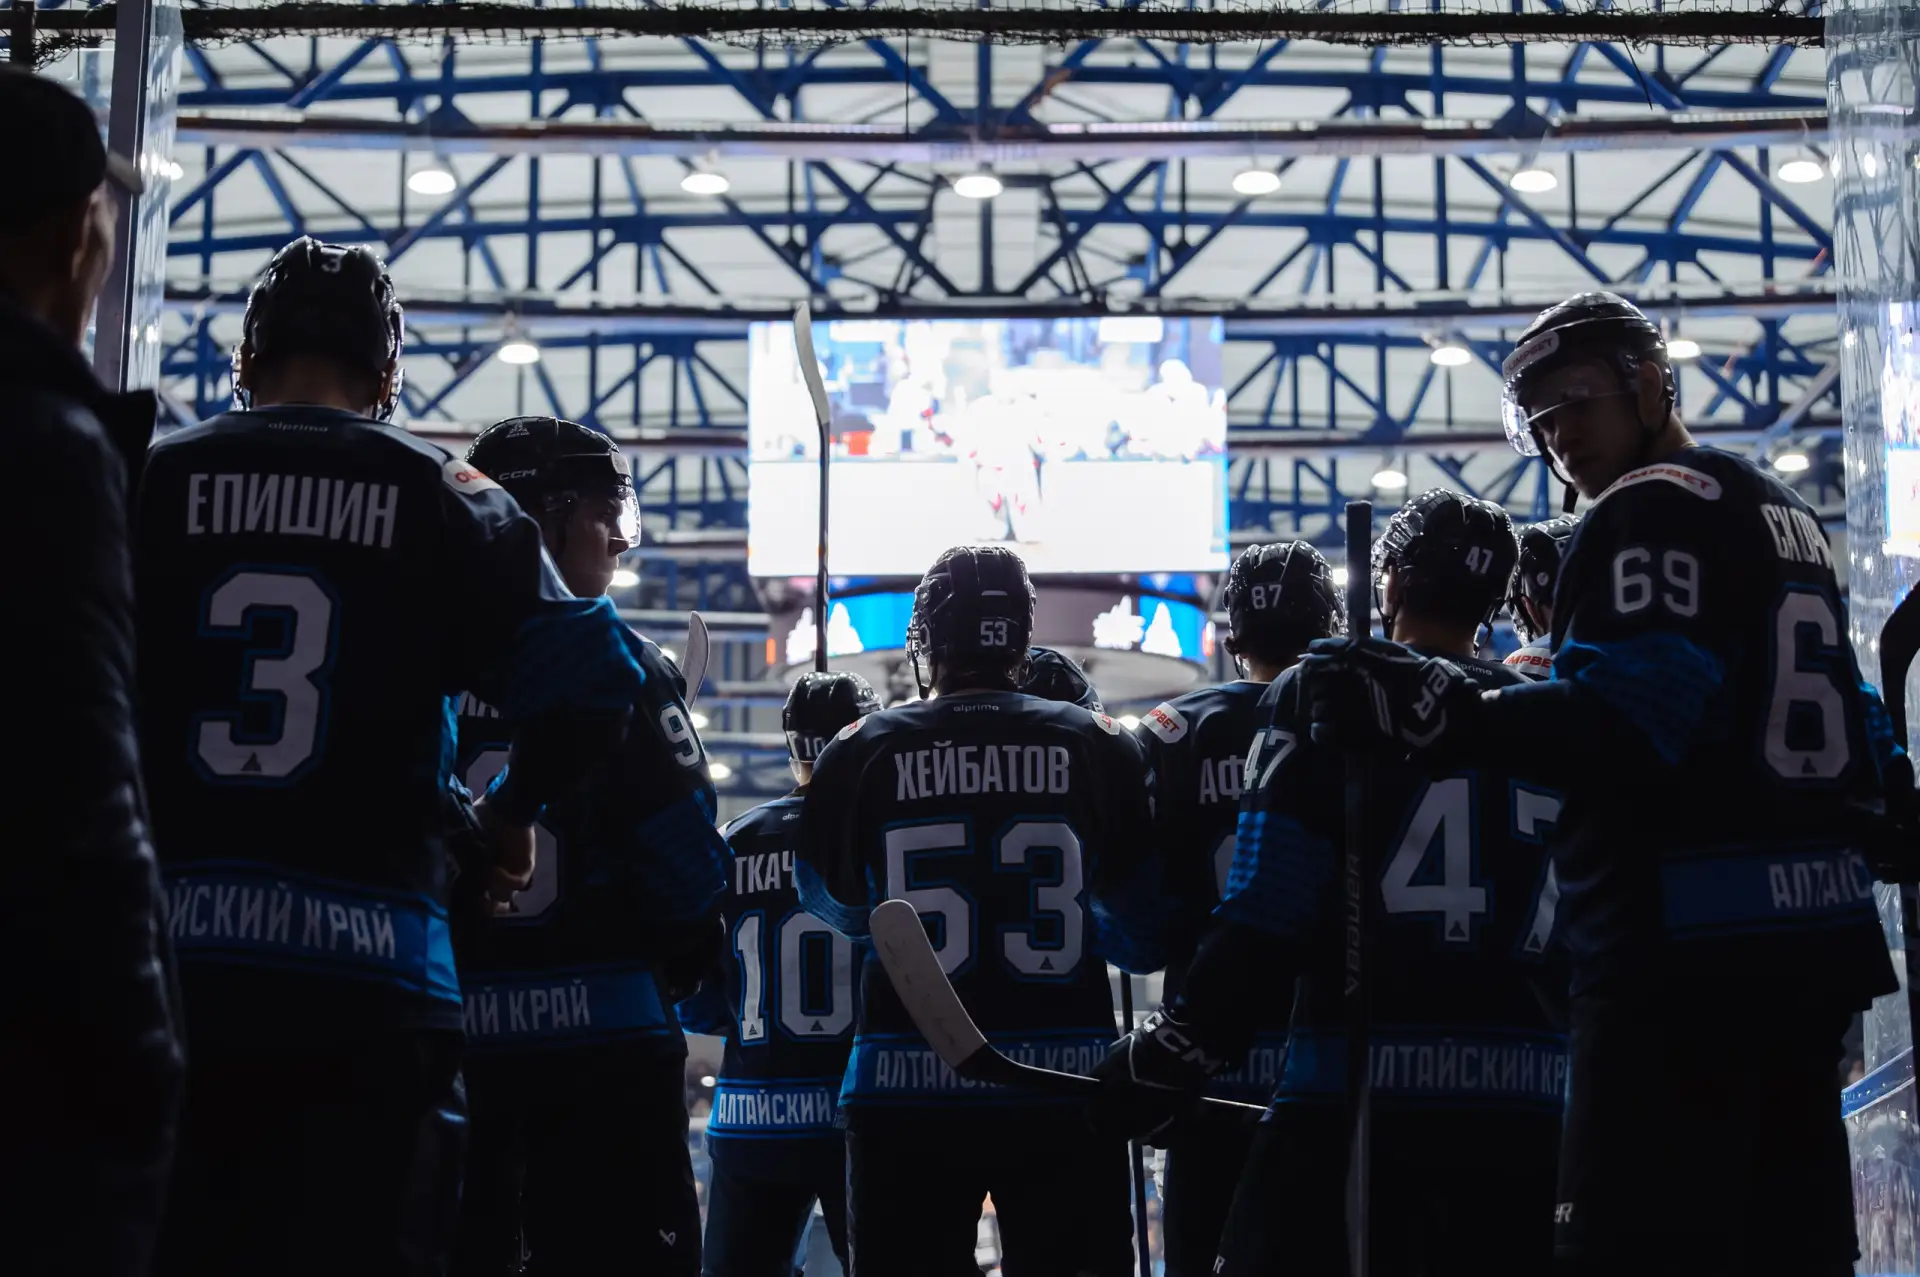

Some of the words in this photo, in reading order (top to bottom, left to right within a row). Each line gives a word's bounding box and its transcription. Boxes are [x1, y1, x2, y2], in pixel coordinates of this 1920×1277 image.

[320, 255, 342, 274] 3
[1506, 337, 1553, 372] LIMPBET
[268, 420, 330, 433] alprima
[498, 468, 538, 482] CCM
[187, 472, 399, 550] ЕПИШИН
[1465, 546, 1494, 575] 47
[1613, 546, 1699, 618] 69
[1251, 584, 1283, 611] 87
[980, 620, 1008, 647] 53
[198, 571, 332, 778] 3
[1764, 591, 1850, 779] 6
[953, 702, 1000, 714] alprima
[894, 740, 1070, 801] ХЕЙБАТОВ
[1243, 729, 1298, 791] 47
[735, 851, 797, 895] ТКАЧ
[885, 822, 1084, 976] 53
[169, 876, 294, 945] ЙСКИЙ
[302, 893, 397, 961] КРАЙ
[737, 911, 854, 1041] 10
[508, 977, 592, 1033] КРАЙ
[1368, 1036, 1535, 1091] ЛТАЙСКИЙ
[717, 1087, 833, 1126] АЛТАЙСКИЙ
